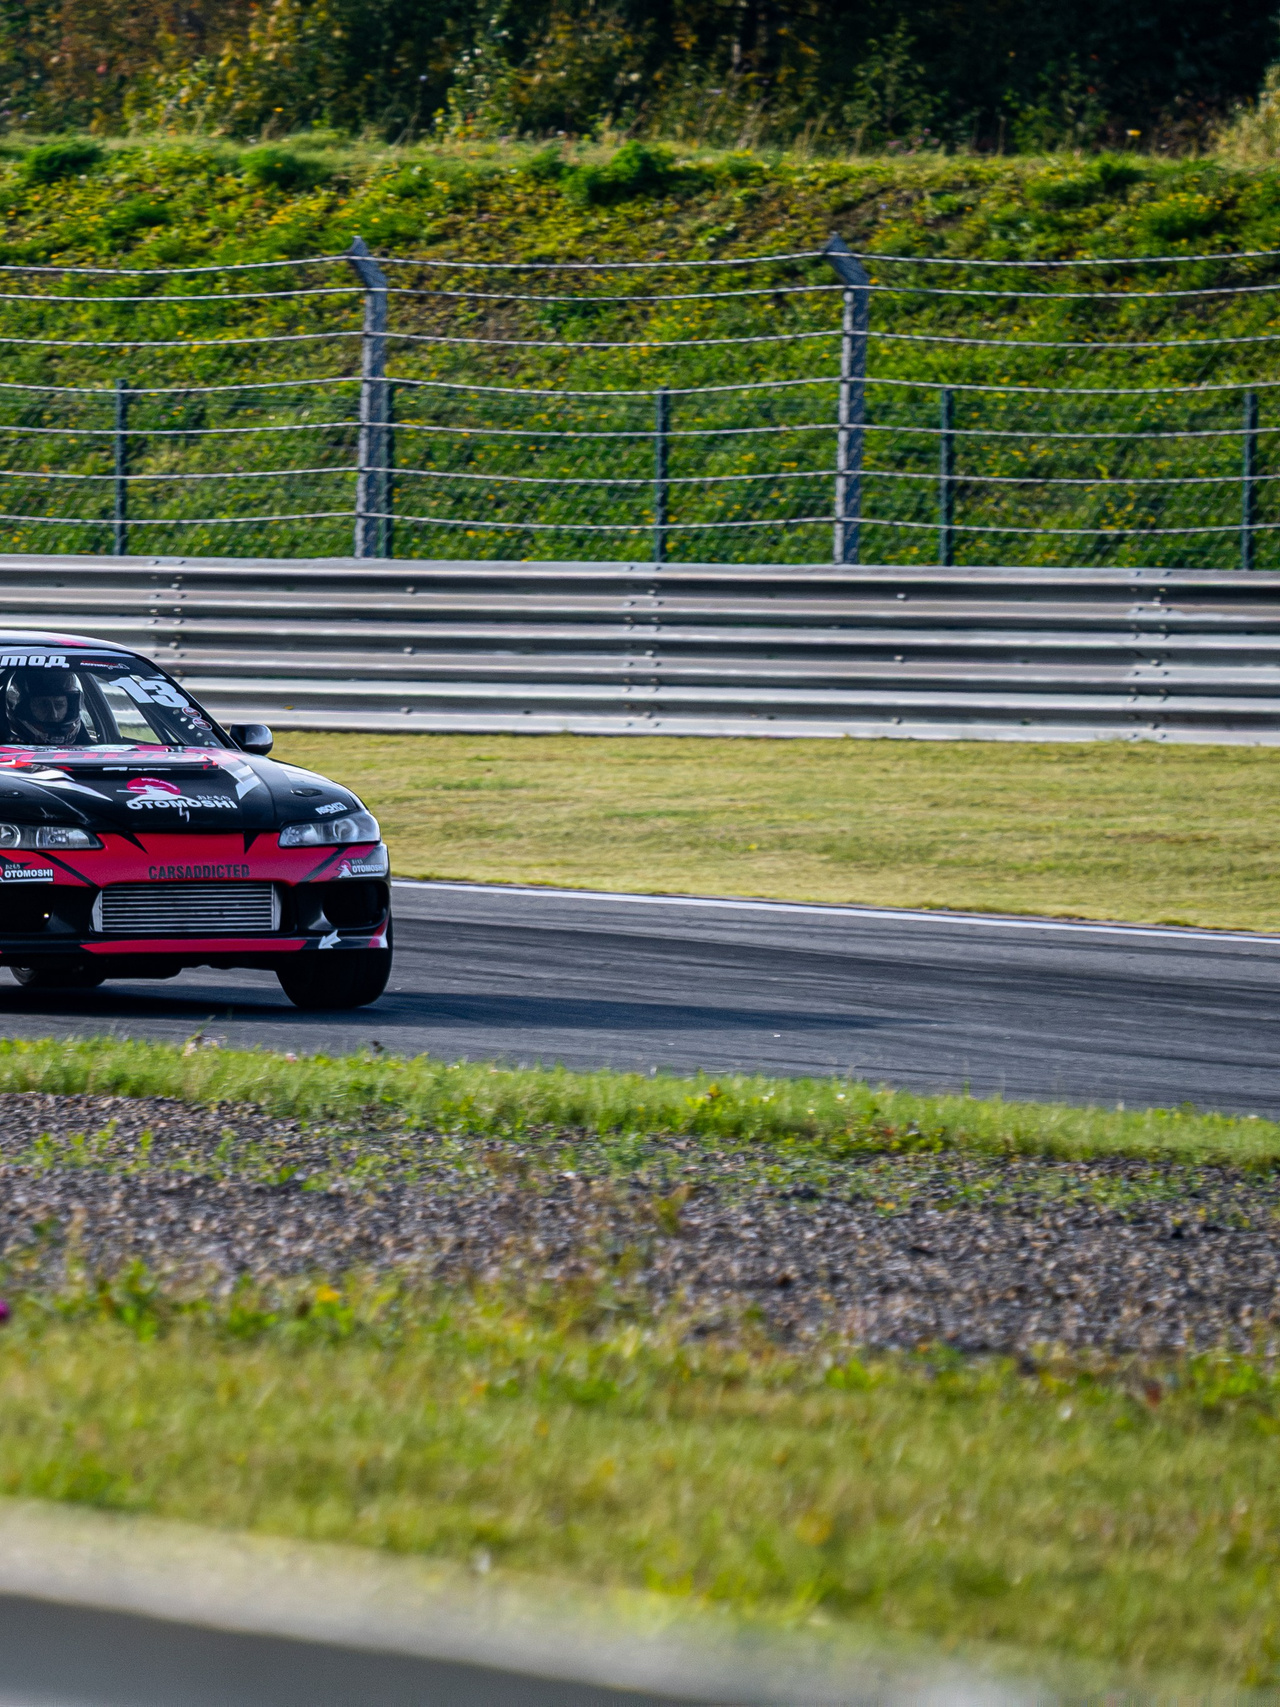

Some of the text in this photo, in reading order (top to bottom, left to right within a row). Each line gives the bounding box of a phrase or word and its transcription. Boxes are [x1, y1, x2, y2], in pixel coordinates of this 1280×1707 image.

[109, 676, 190, 708] 13
[126, 800, 238, 810] OTOMOSHI
[4, 869, 53, 878] OTOMOSHI
[148, 864, 251, 879] CARSADDICTED
